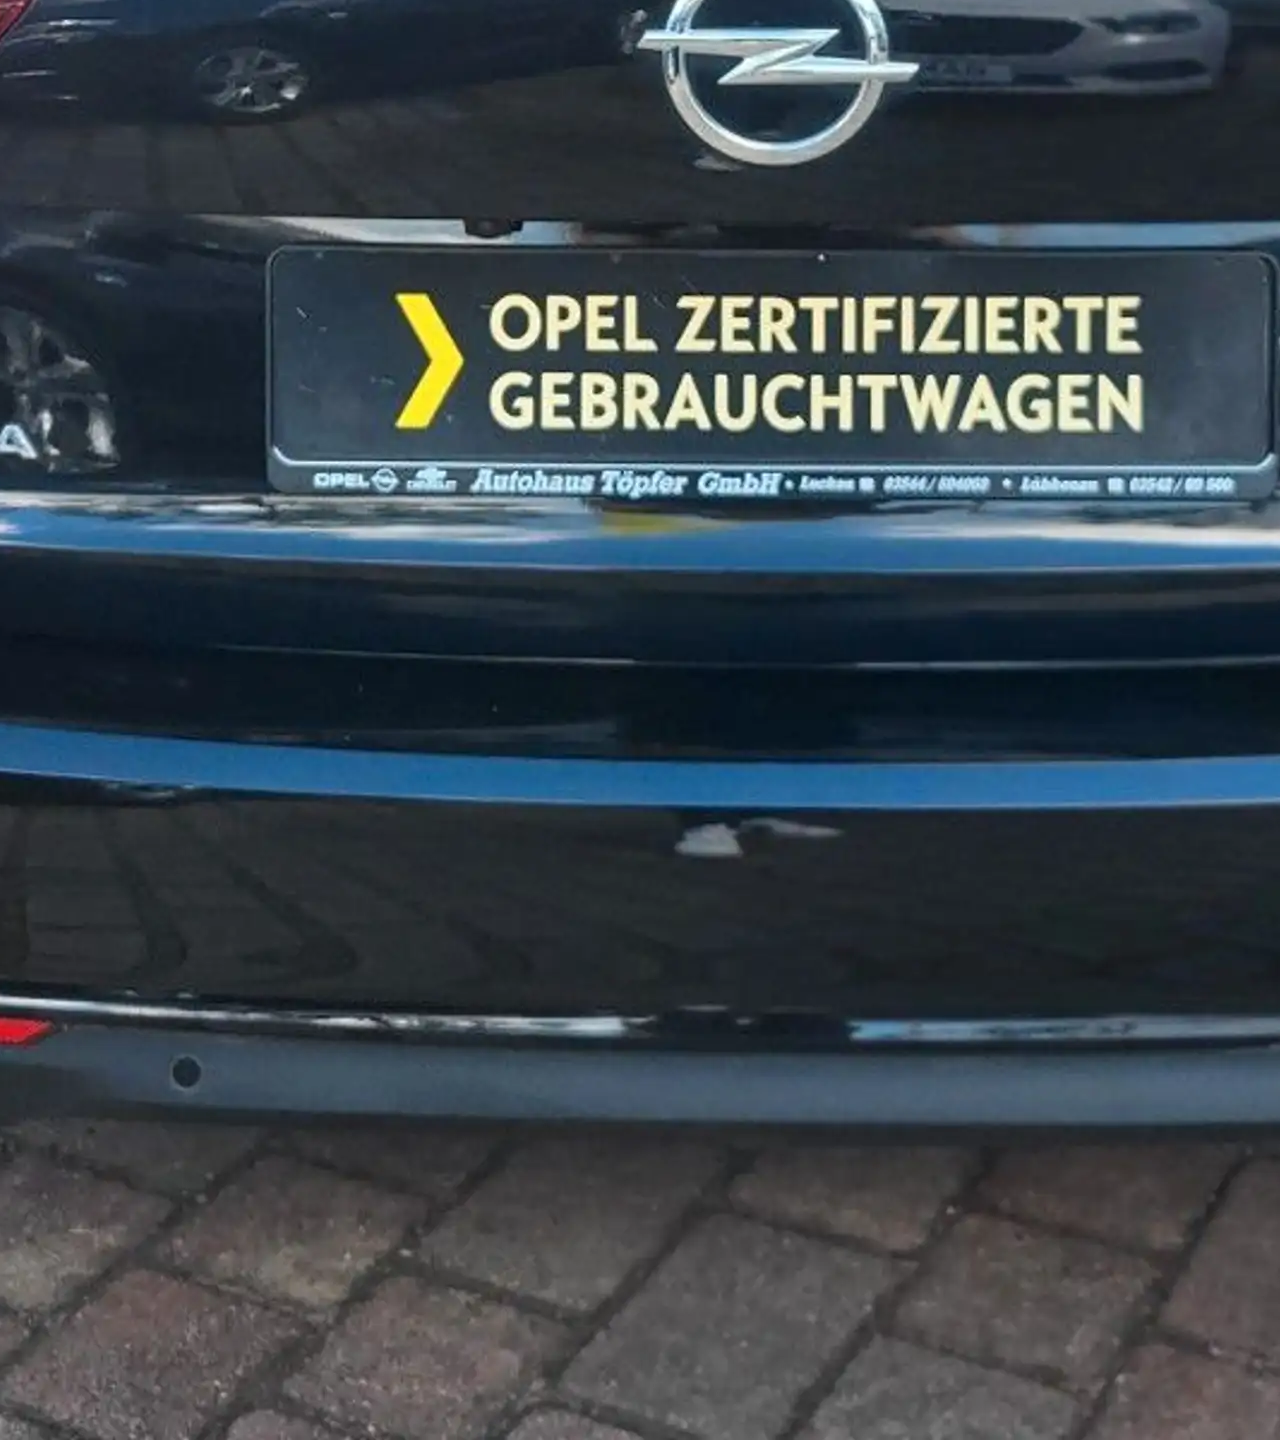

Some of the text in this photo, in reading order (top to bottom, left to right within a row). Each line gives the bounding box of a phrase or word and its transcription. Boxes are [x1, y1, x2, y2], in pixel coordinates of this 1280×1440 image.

[488, 292, 1144, 354] OPEL ZERTIFIZIERTE
[488, 370, 1144, 433] GEBRAUCHTWAGEN
[313, 471, 371, 490] OPEL
[470, 467, 595, 494] Autohaus
[599, 468, 689, 499] Töpfer
[696, 471, 784, 496] GmbH
